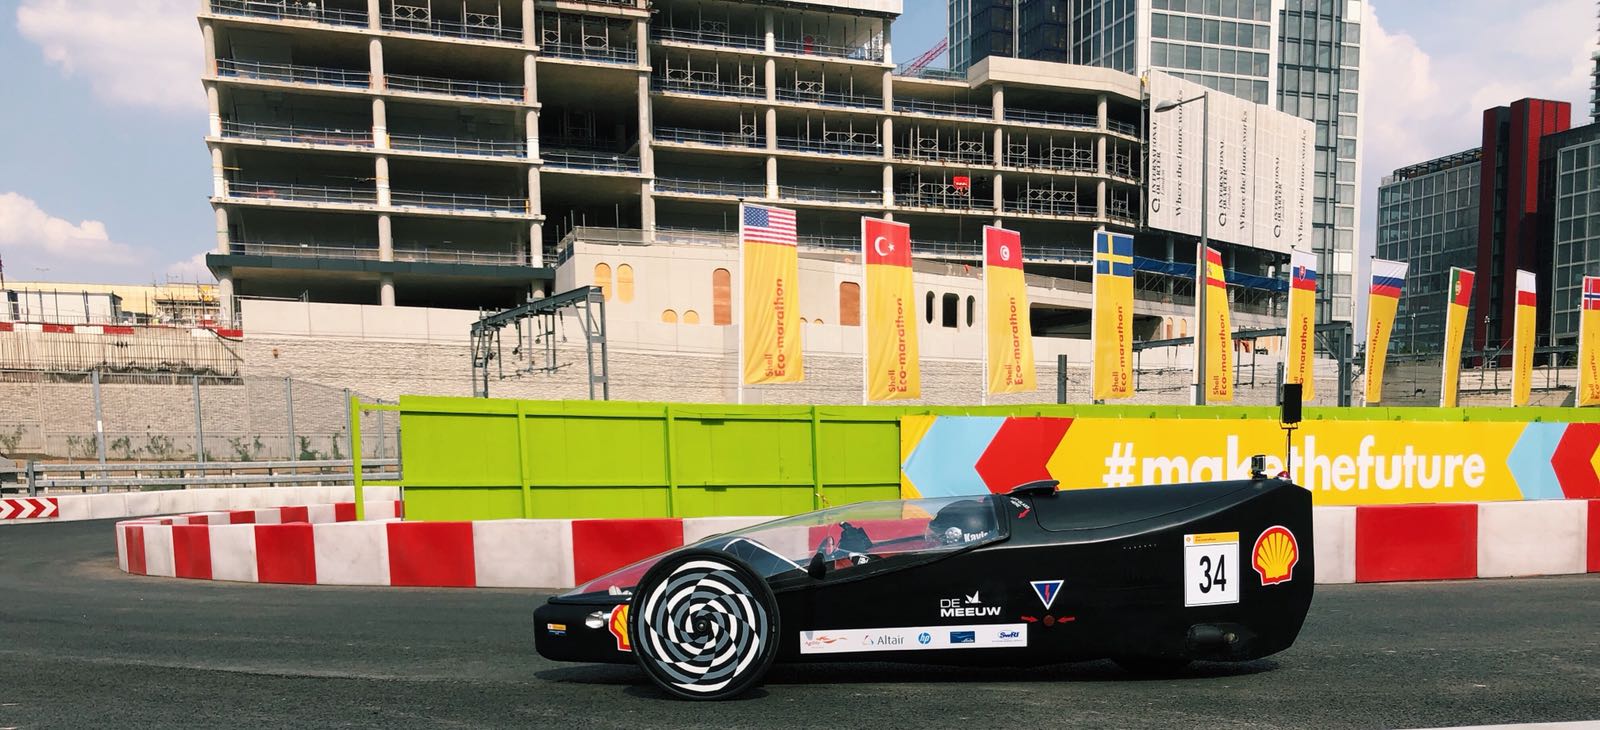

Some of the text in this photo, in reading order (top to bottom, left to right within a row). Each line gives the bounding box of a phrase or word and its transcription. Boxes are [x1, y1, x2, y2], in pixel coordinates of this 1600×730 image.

[774, 278, 785, 377] Eco-marathon
[895, 298, 907, 392] Eco-marathon
[1009, 297, 1023, 385] Eco-marathon
[764, 353, 773, 376] Shell
[1117, 306, 1127, 392] Eco-marathon
[1219, 314, 1227, 396] Eco-marathon
[1298, 317, 1308, 385] o-marathon
[888, 369, 896, 392] Shell
[1004, 364, 1013, 386] Shell
[1199, 554, 1227, 594] 34
[940, 598, 960, 608] DE
[940, 606, 1002, 617] MEEUW
[877, 635, 905, 645] Altair
[919, 632, 931, 645] hp
